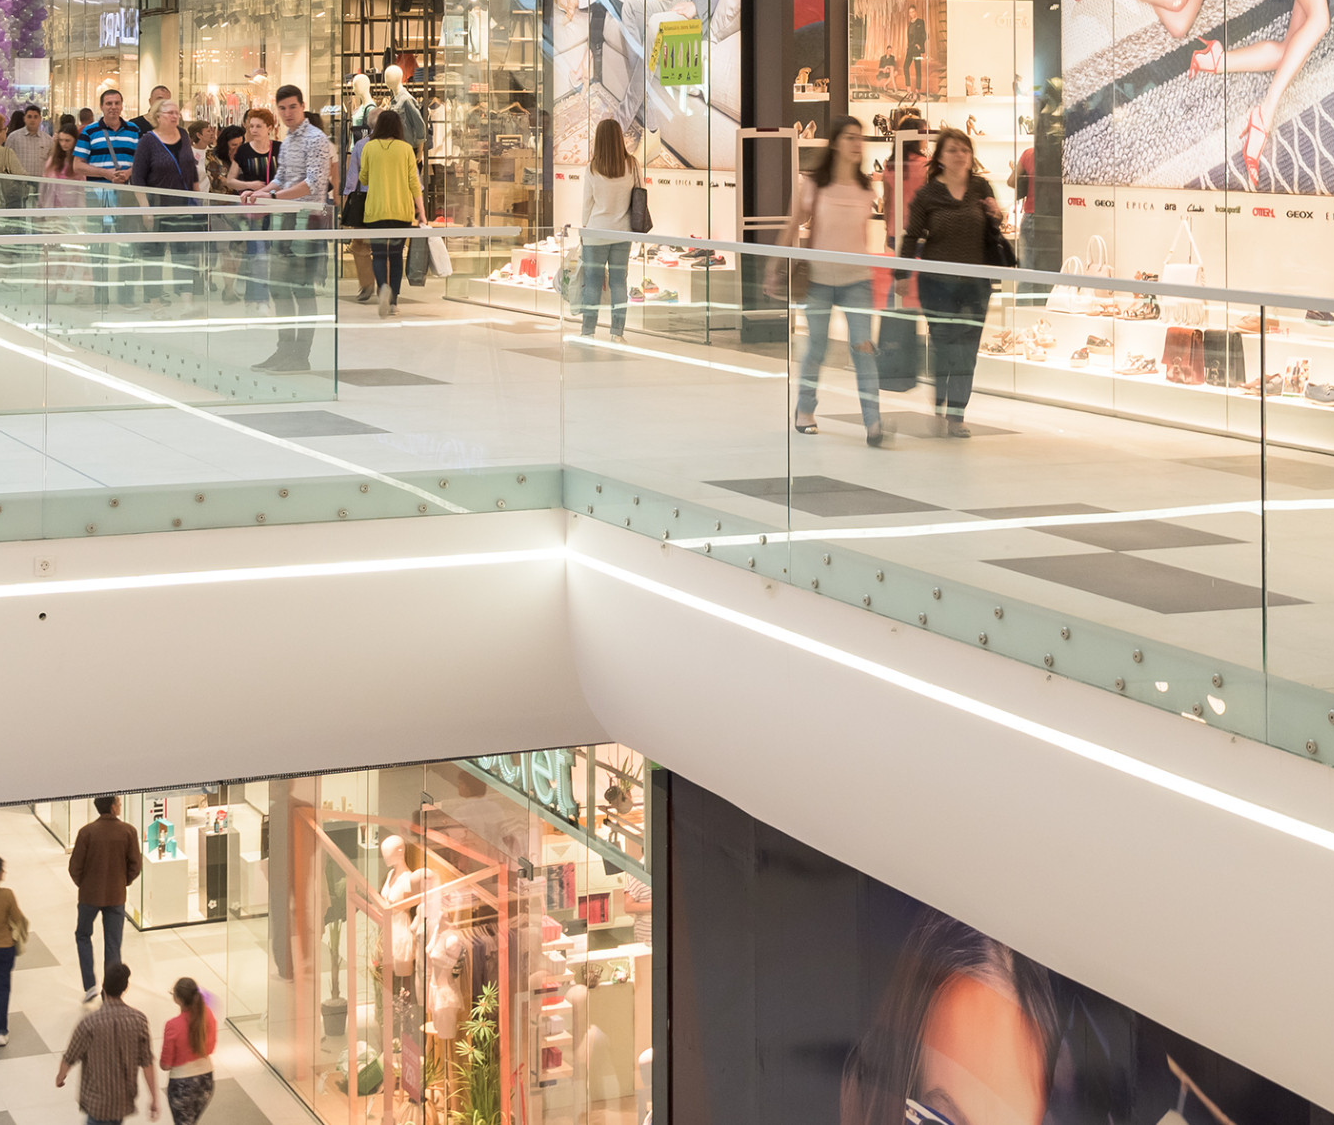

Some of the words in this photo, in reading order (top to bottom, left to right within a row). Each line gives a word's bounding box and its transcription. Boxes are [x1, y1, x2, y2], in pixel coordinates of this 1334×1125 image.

[1126, 201, 1155, 211] EPICA
[1164, 203, 1177, 211] ara
[1286, 210, 1314, 219] GEOX
